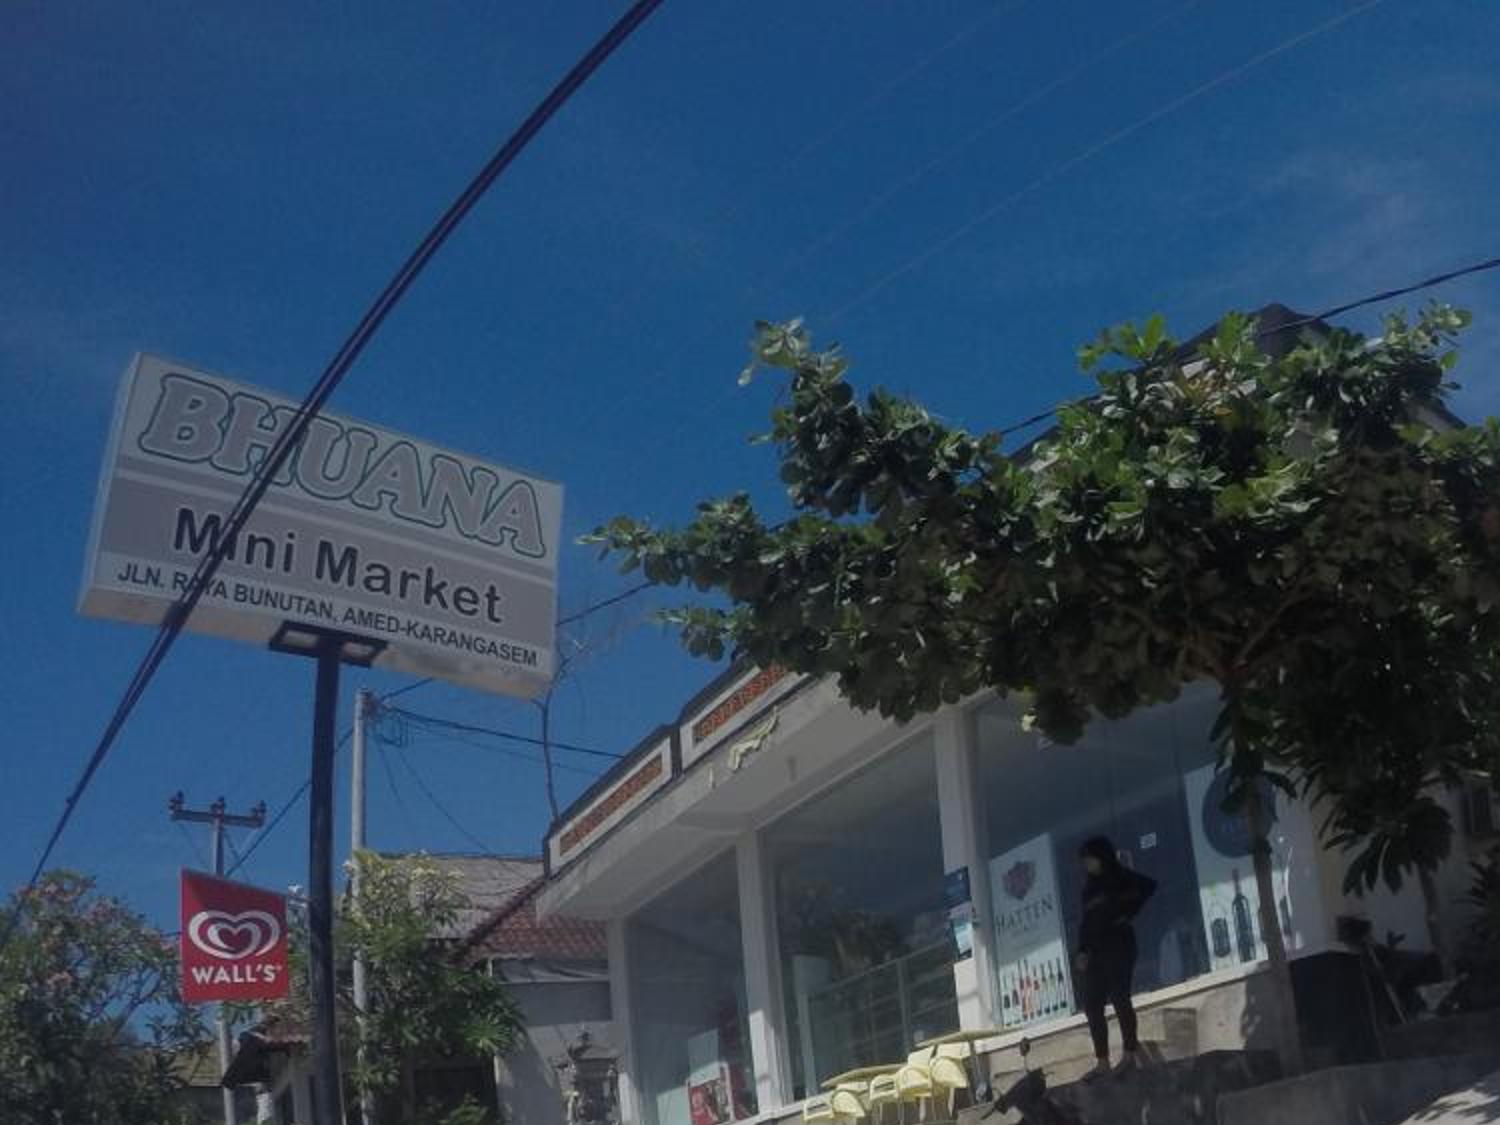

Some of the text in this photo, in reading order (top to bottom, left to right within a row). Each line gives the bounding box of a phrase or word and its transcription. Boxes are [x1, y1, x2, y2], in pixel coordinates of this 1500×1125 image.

[139, 373, 546, 557] BHUANA
[117, 563, 164, 588] JLN.
[343, 608, 537, 666] AMED-KARANGASEM
[317, 541, 502, 623] Market
[191, 963, 276, 985] WALL'S
